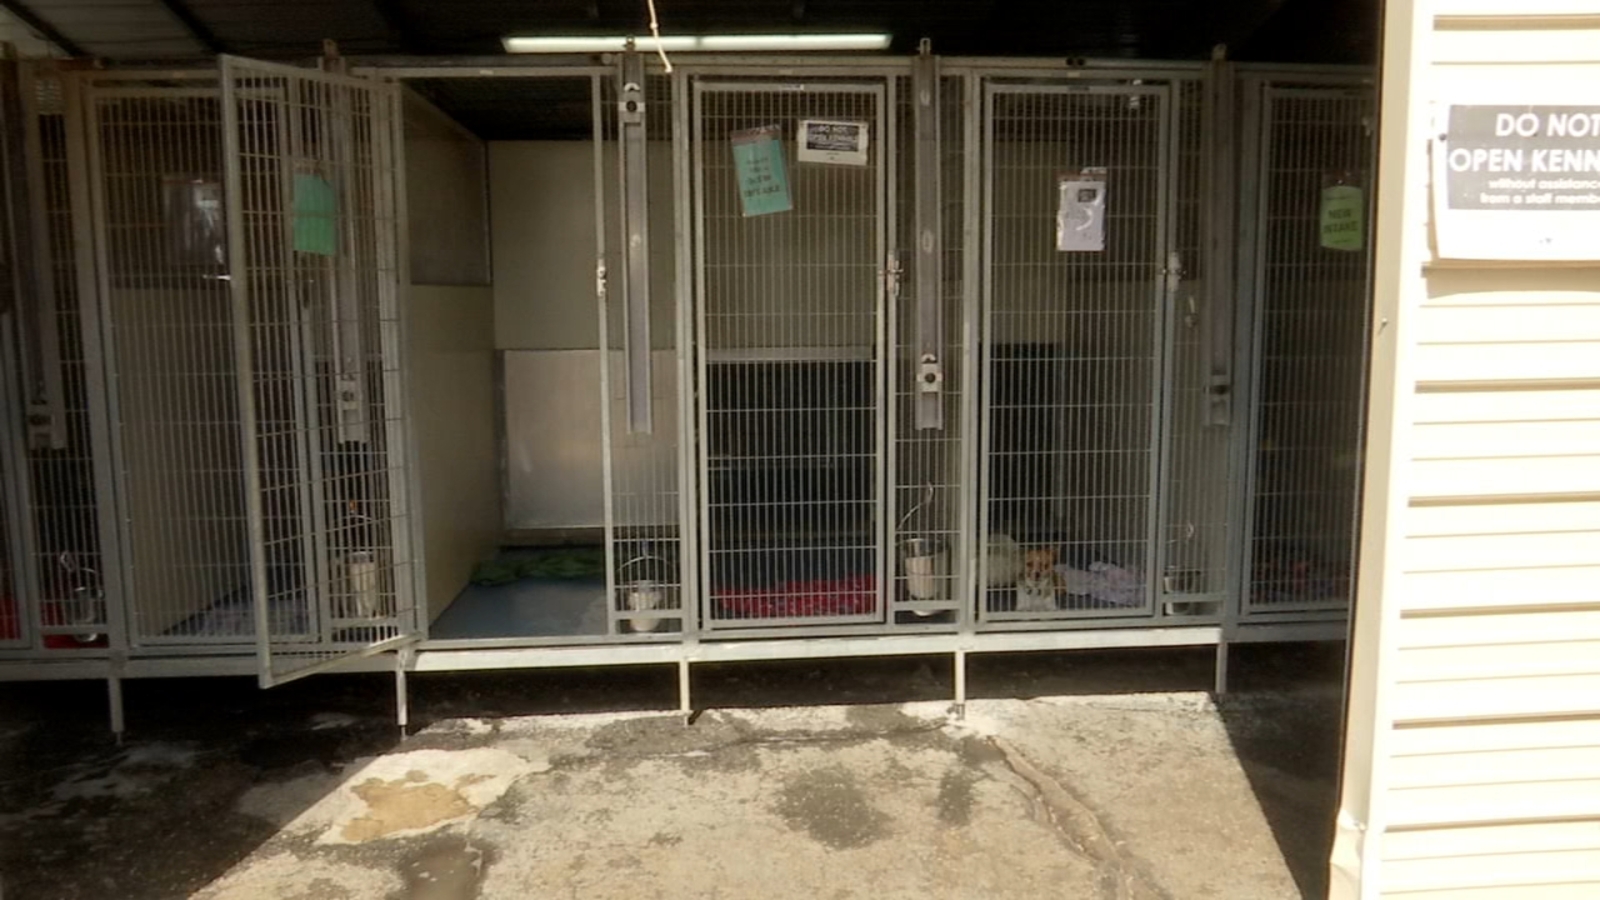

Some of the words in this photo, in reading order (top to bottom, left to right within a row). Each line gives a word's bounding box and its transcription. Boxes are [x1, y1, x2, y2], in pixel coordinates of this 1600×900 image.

[1495, 113, 1540, 137] DO
[1547, 113, 1600, 137] NOT
[1450, 148, 1522, 172] OPEN
[1489, 178, 1537, 189] without
[1480, 192, 1511, 204] from
[1513, 195, 1523, 204] a
[1525, 193, 1553, 204] staff
